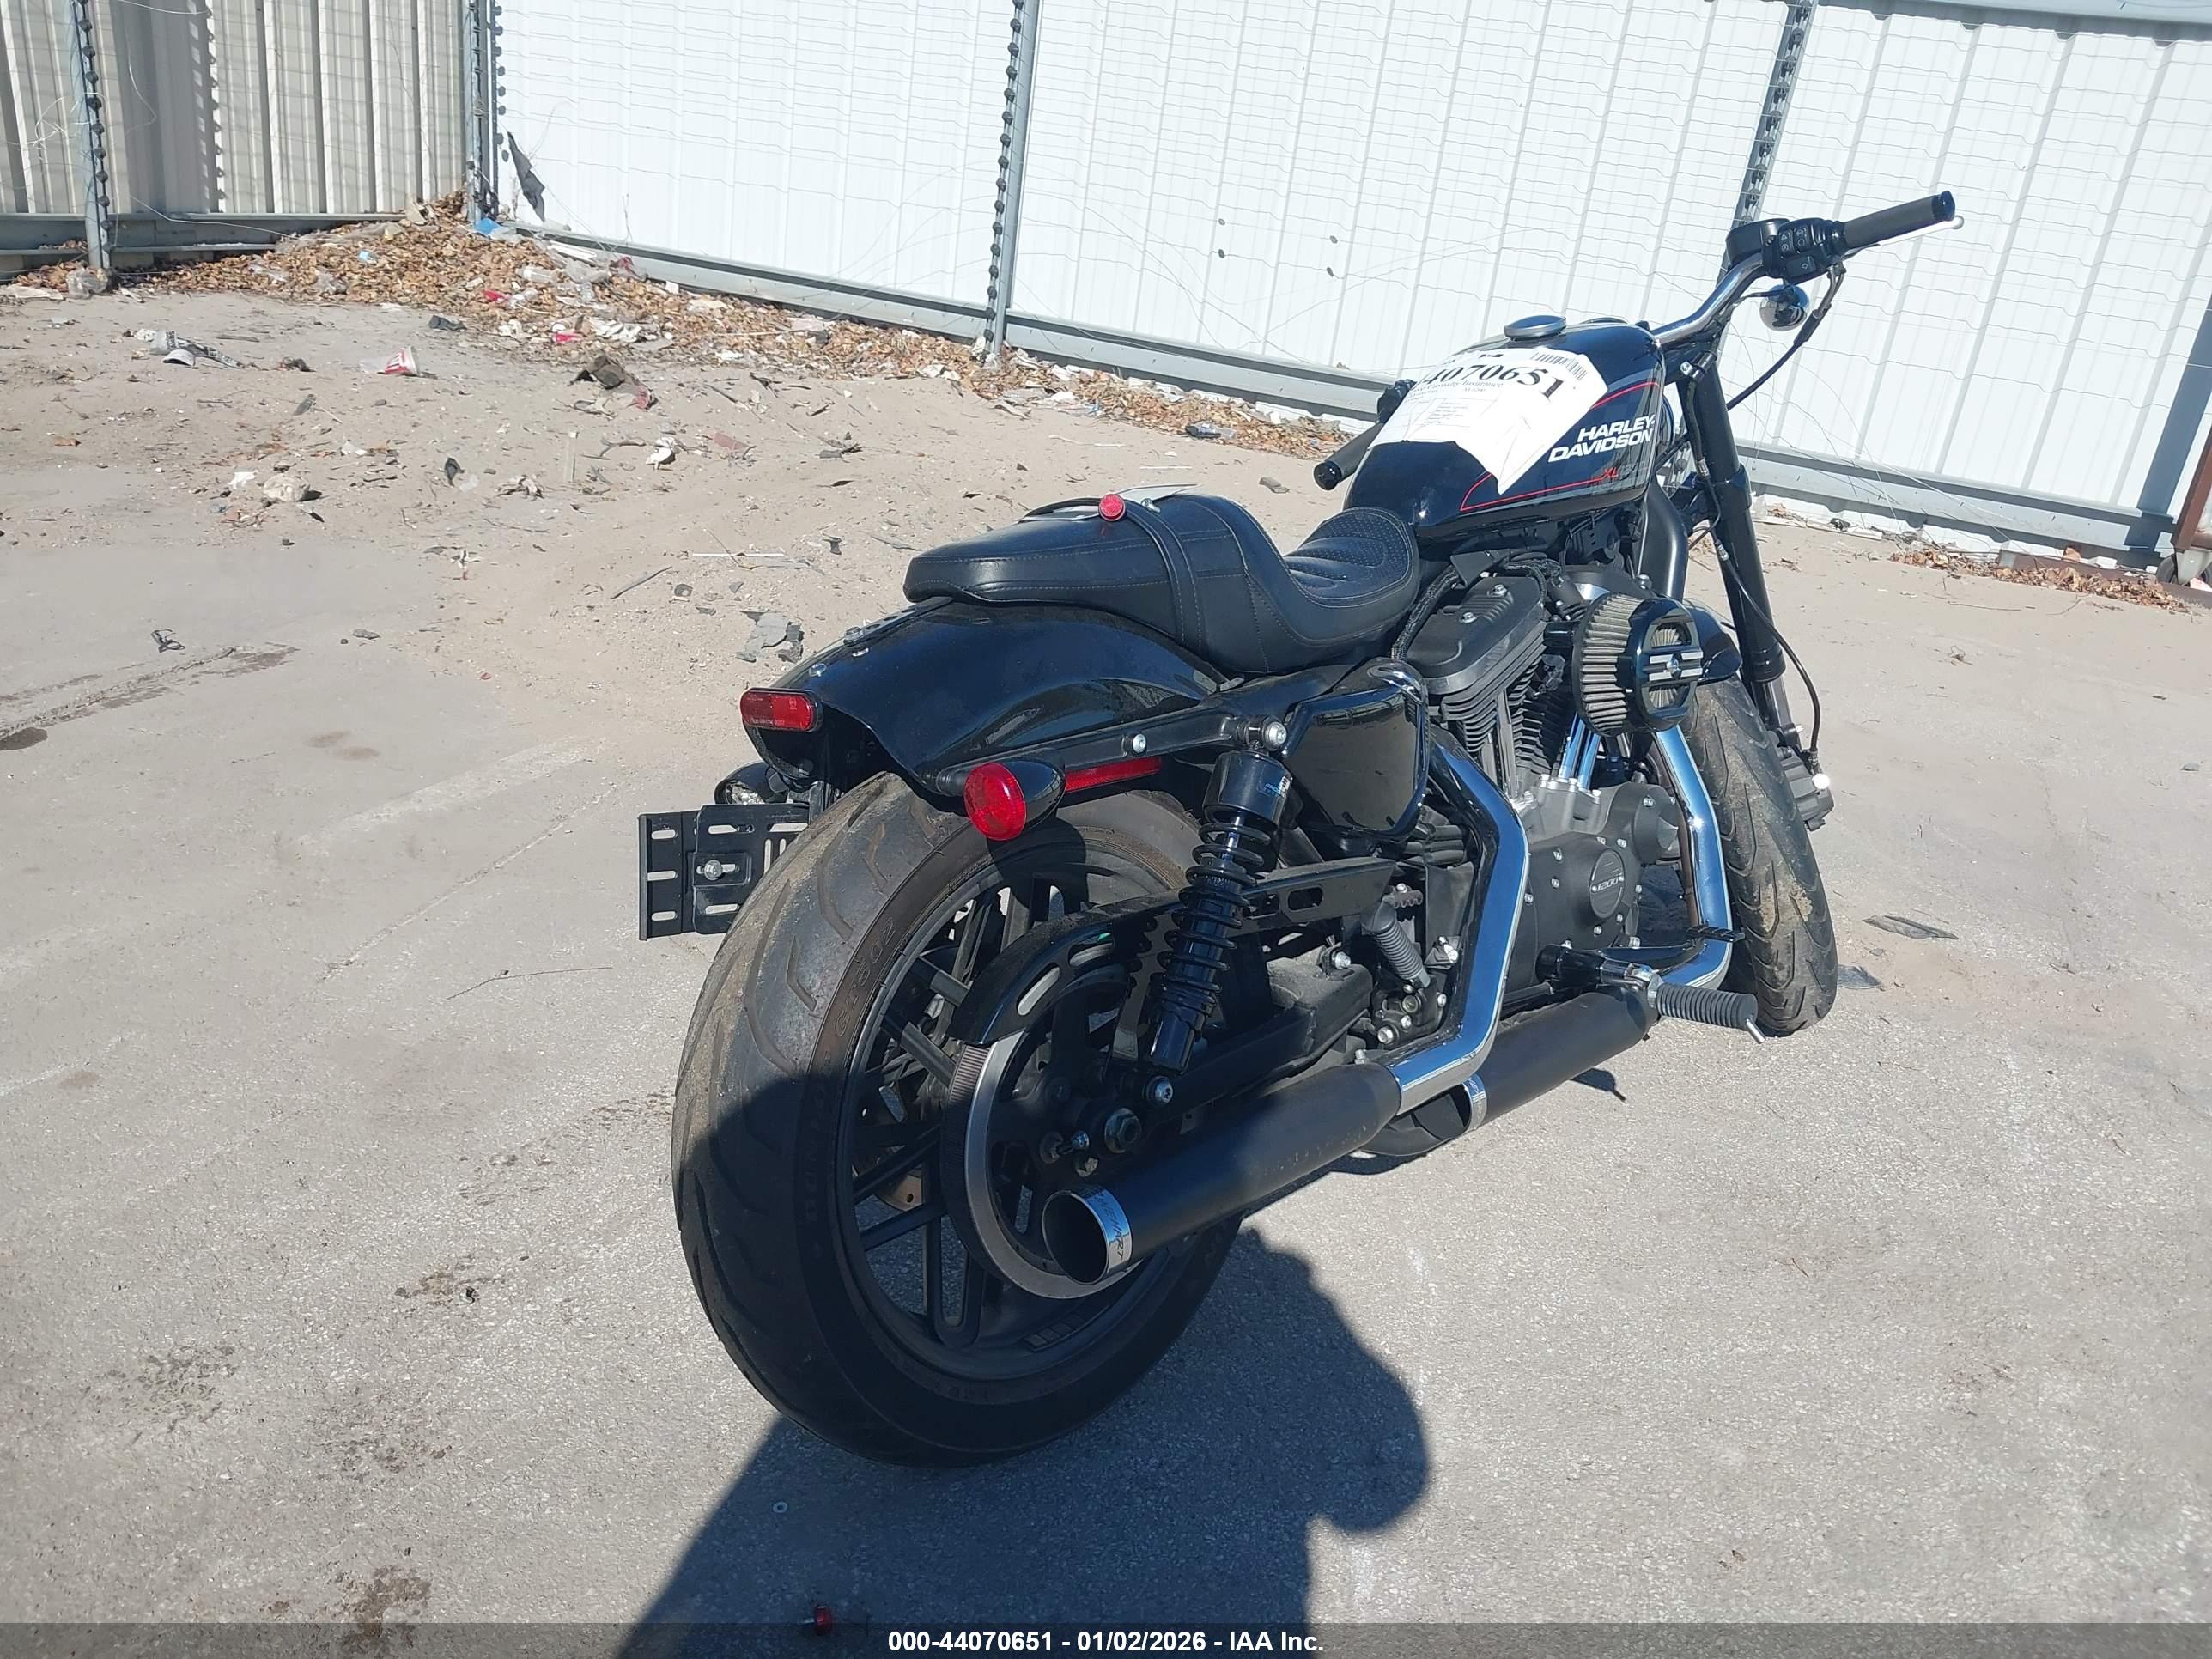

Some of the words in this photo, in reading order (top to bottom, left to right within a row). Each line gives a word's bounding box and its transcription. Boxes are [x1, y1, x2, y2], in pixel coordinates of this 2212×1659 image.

[1547, 428, 1655, 463] DAVIDSON
[1604, 466, 1620, 478] XL
[1597, 877, 1619, 891] 1200
